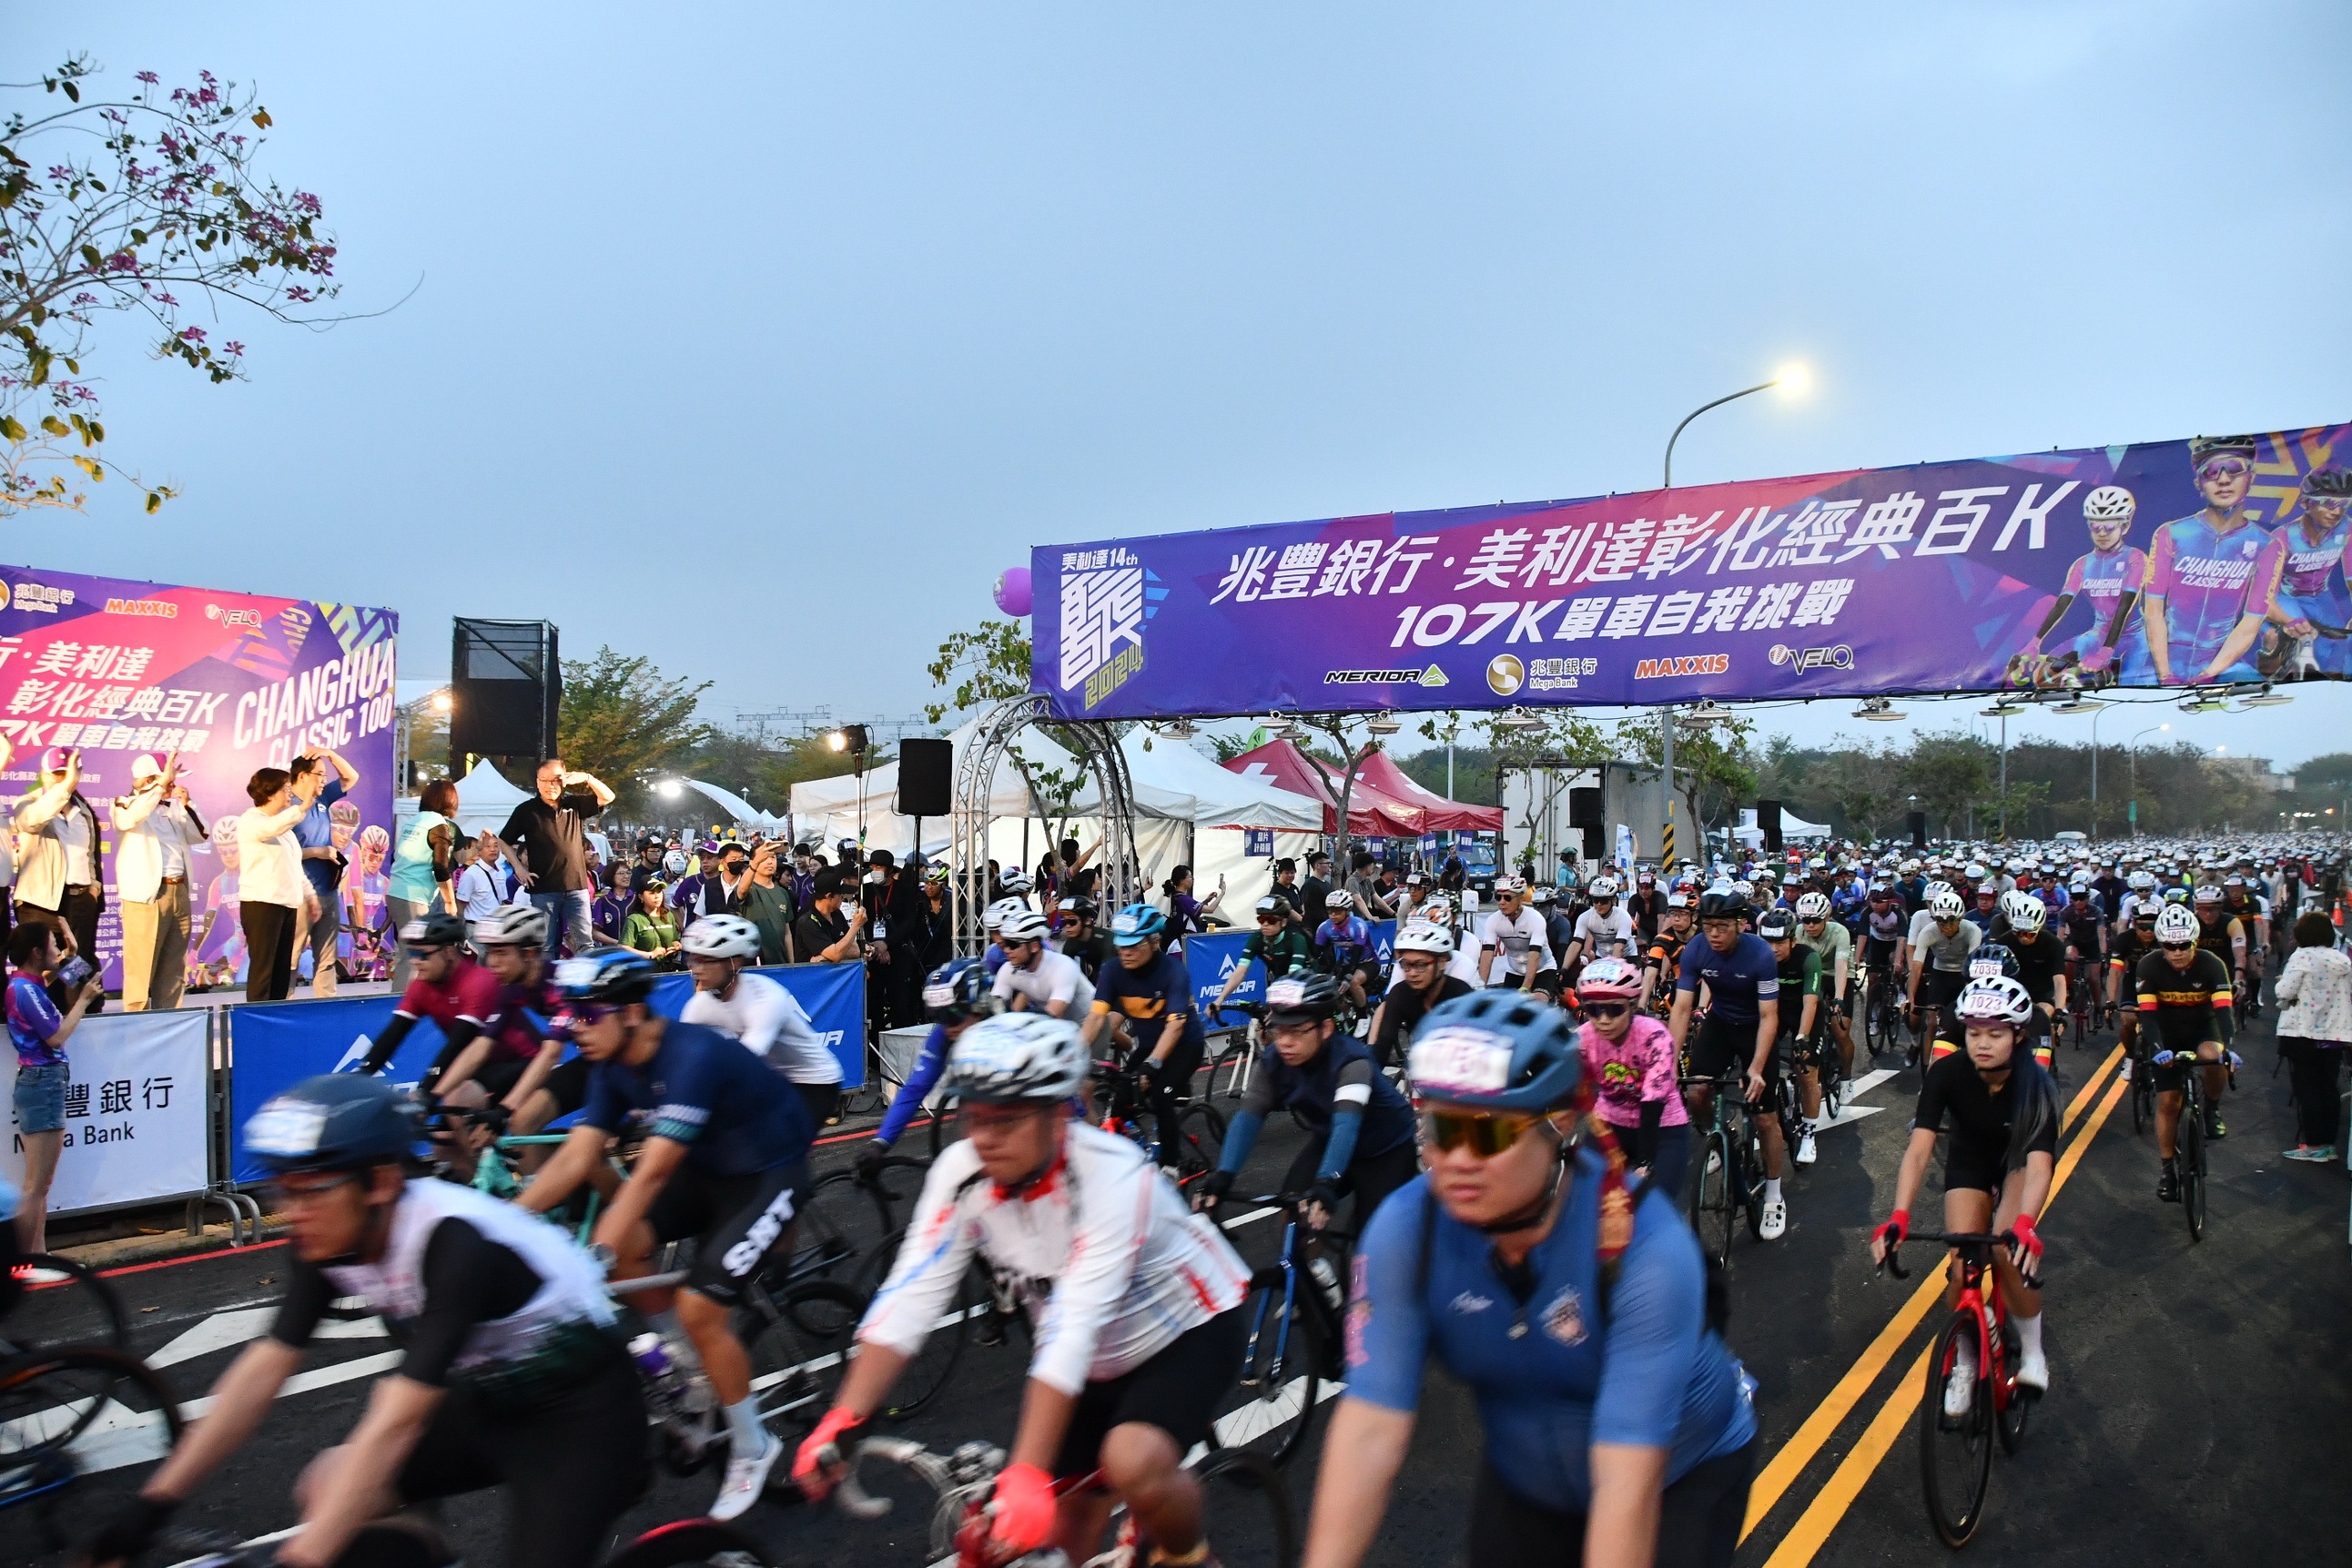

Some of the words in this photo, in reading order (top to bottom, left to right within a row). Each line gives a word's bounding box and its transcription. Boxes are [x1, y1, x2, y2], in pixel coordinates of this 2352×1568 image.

[1061, 550, 1109, 572] 美利達
[1110, 547, 1138, 567] 14th
[2175, 556, 2255, 579] CHANGHUA
[2181, 574, 2225, 588] CLASSIC
[2223, 579, 2245, 590] 100
[15, 583, 75, 604] 兆豐銀行
[105, 598, 177, 618] MAXXIS
[219, 609, 261, 628] VELO
[1531, 659, 1597, 676] 兆豐銀行
[1635, 653, 1729, 679] MAXXIS
[1789, 644, 1853, 675] VELO
[1085, 642, 1144, 711] 2024
[1324, 669, 1421, 683] MERIDA
[1530, 678, 1555, 690] Mega
[1556, 677, 1577, 688] Bank
[5, 678, 228, 725] 彰化經典百K
[233, 638, 394, 750] CHANGHUA
[359, 692, 393, 737] 100
[1973, 965, 1998, 976] 7035
[1200, 980, 1256, 998] MEDA
[1970, 996, 2002, 1012] 7023
[12, 1077, 174, 1126] 豐銀行
[85, 1121, 135, 1145] Bank
